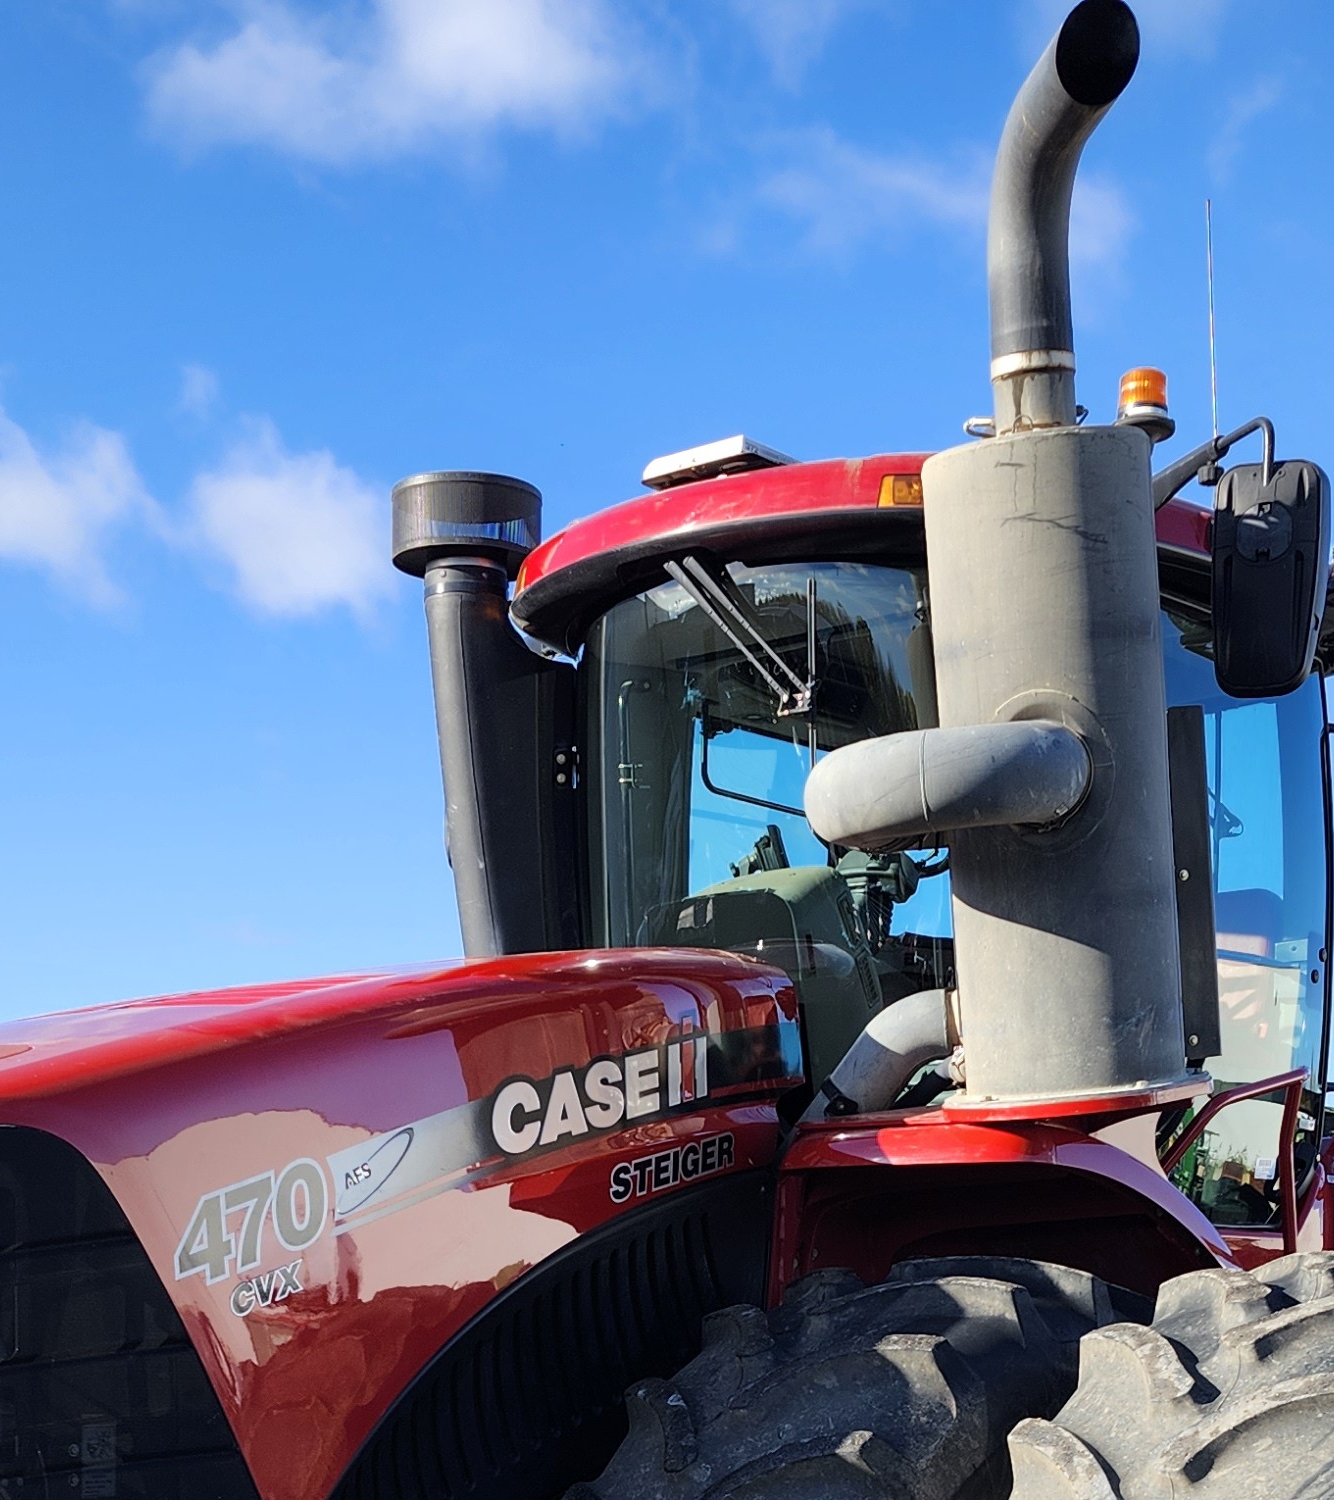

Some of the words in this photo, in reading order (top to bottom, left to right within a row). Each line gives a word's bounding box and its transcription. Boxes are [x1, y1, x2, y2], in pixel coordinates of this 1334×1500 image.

[492, 1049, 660, 1154] CASE
[344, 1162, 372, 1190] AFS
[610, 1132, 734, 1203] STEIGER
[174, 1157, 328, 1286] 470
[230, 1259, 304, 1317] CVX
